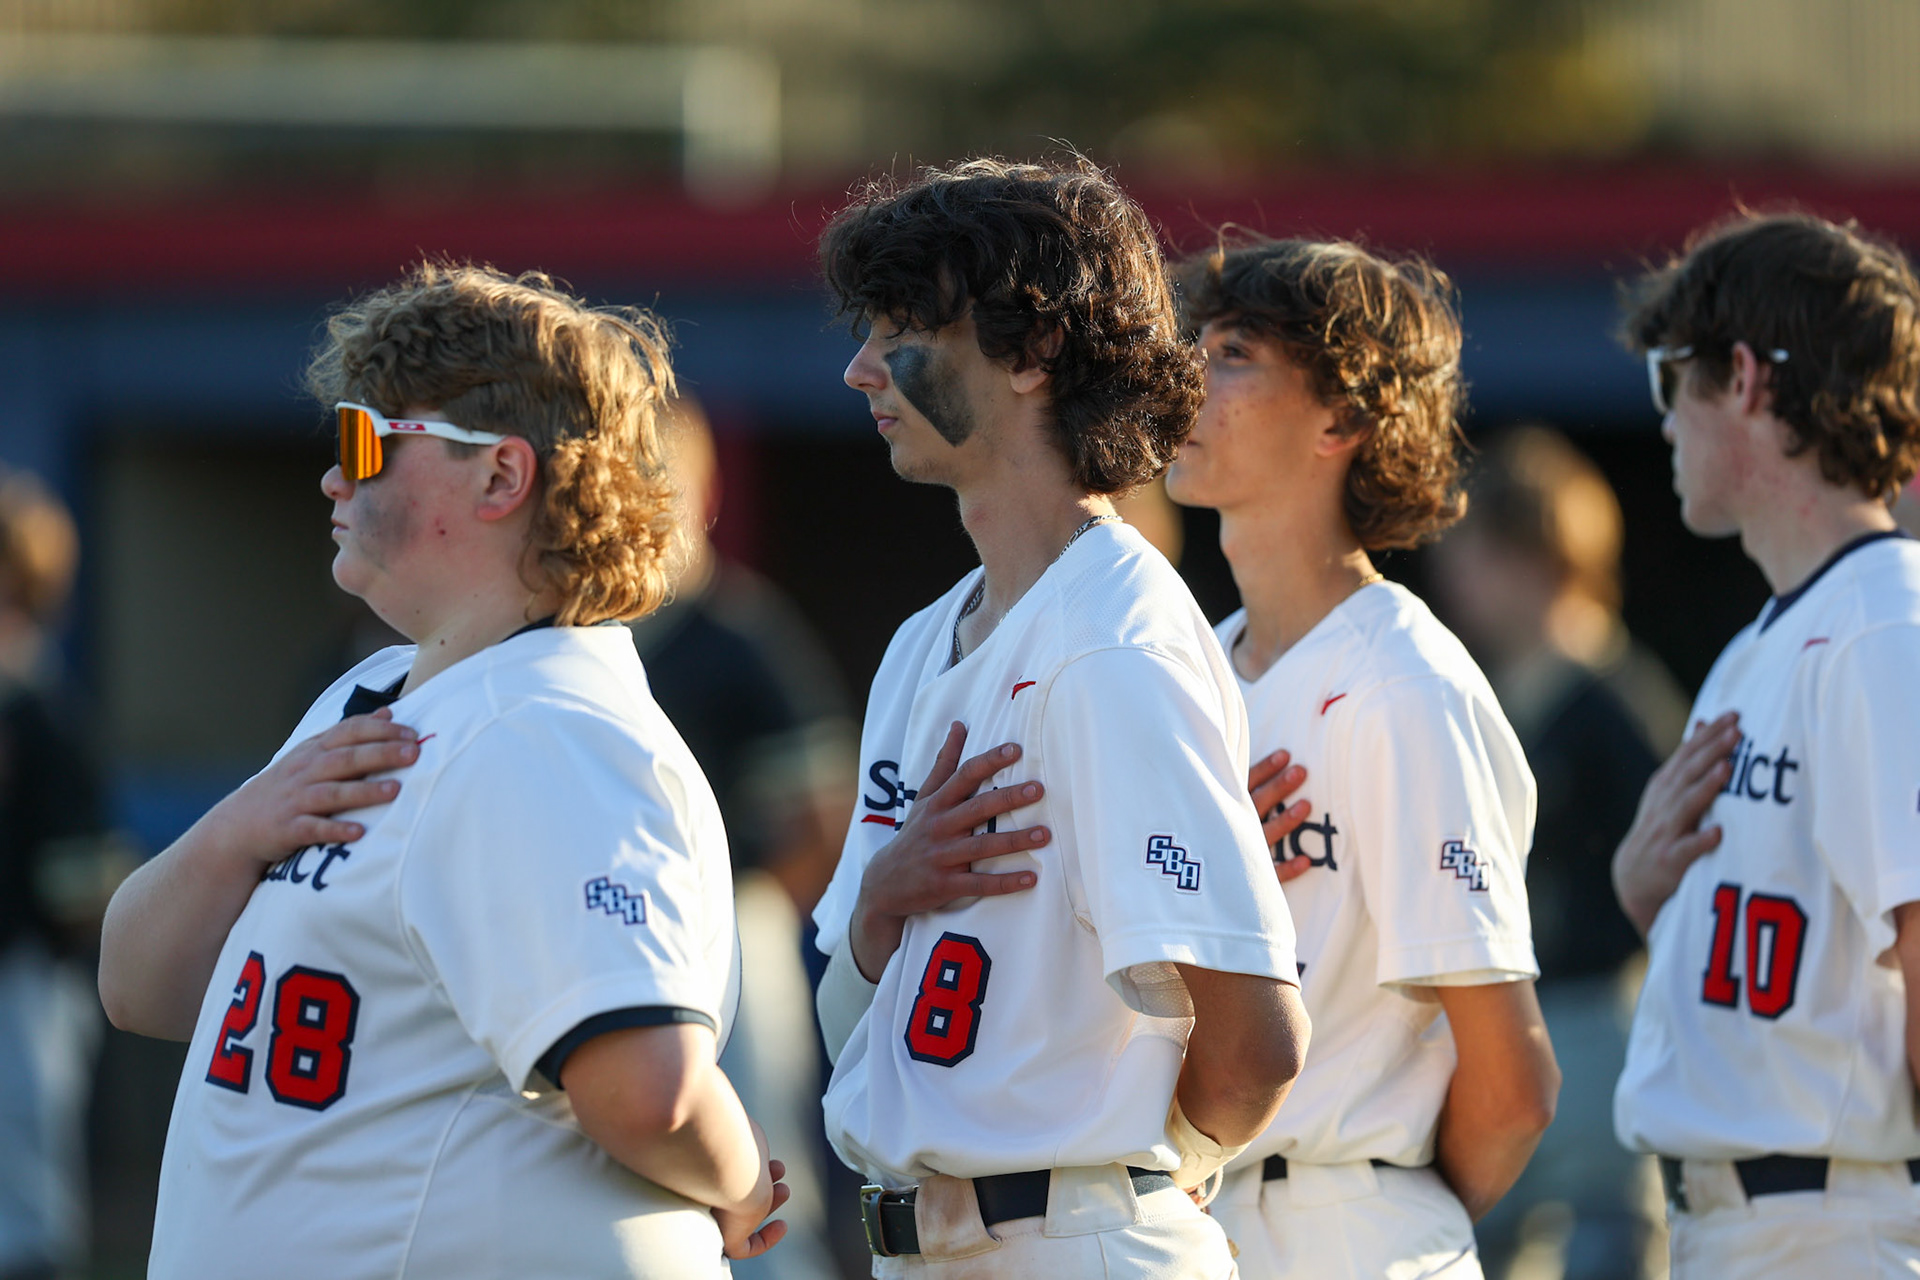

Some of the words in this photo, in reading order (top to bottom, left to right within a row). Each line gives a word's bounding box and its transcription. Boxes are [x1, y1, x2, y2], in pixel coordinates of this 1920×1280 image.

[584, 876, 646, 925] SBA
[1146, 835, 1201, 891] SBA
[1440, 840, 1489, 892] SBA
[903, 931, 992, 1068] 8
[1700, 882, 1809, 1021] 10
[205, 950, 361, 1112] 28
